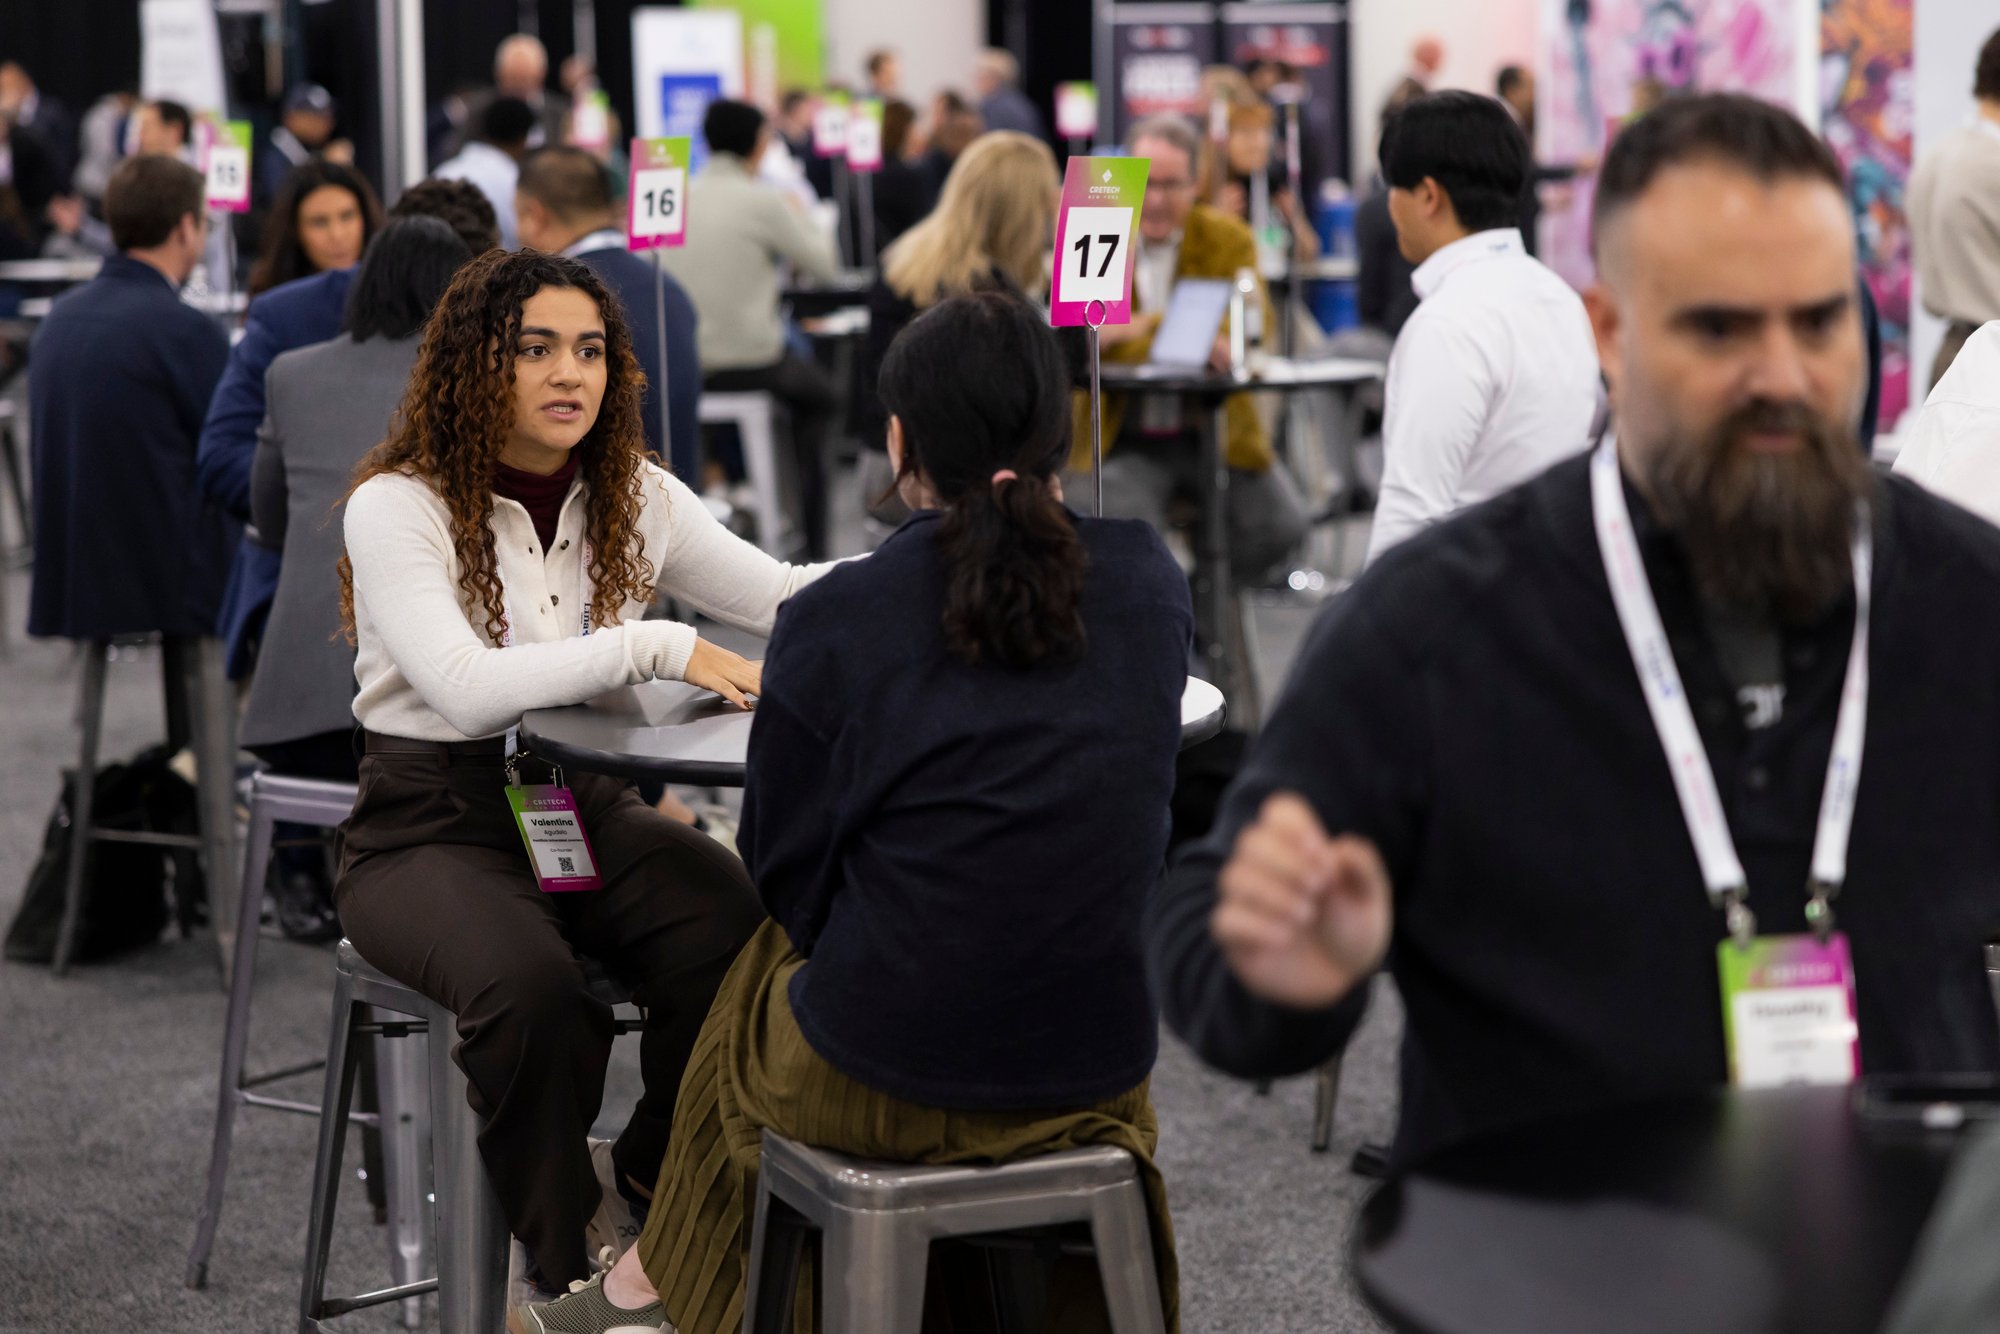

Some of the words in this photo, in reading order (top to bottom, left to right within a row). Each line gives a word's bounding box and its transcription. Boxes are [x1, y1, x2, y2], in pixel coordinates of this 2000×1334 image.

[1089, 186, 1120, 194] CRETECH
[644, 188, 675, 218] 16
[1074, 234, 1120, 278] 17
[531, 818, 574, 826] Valentina
